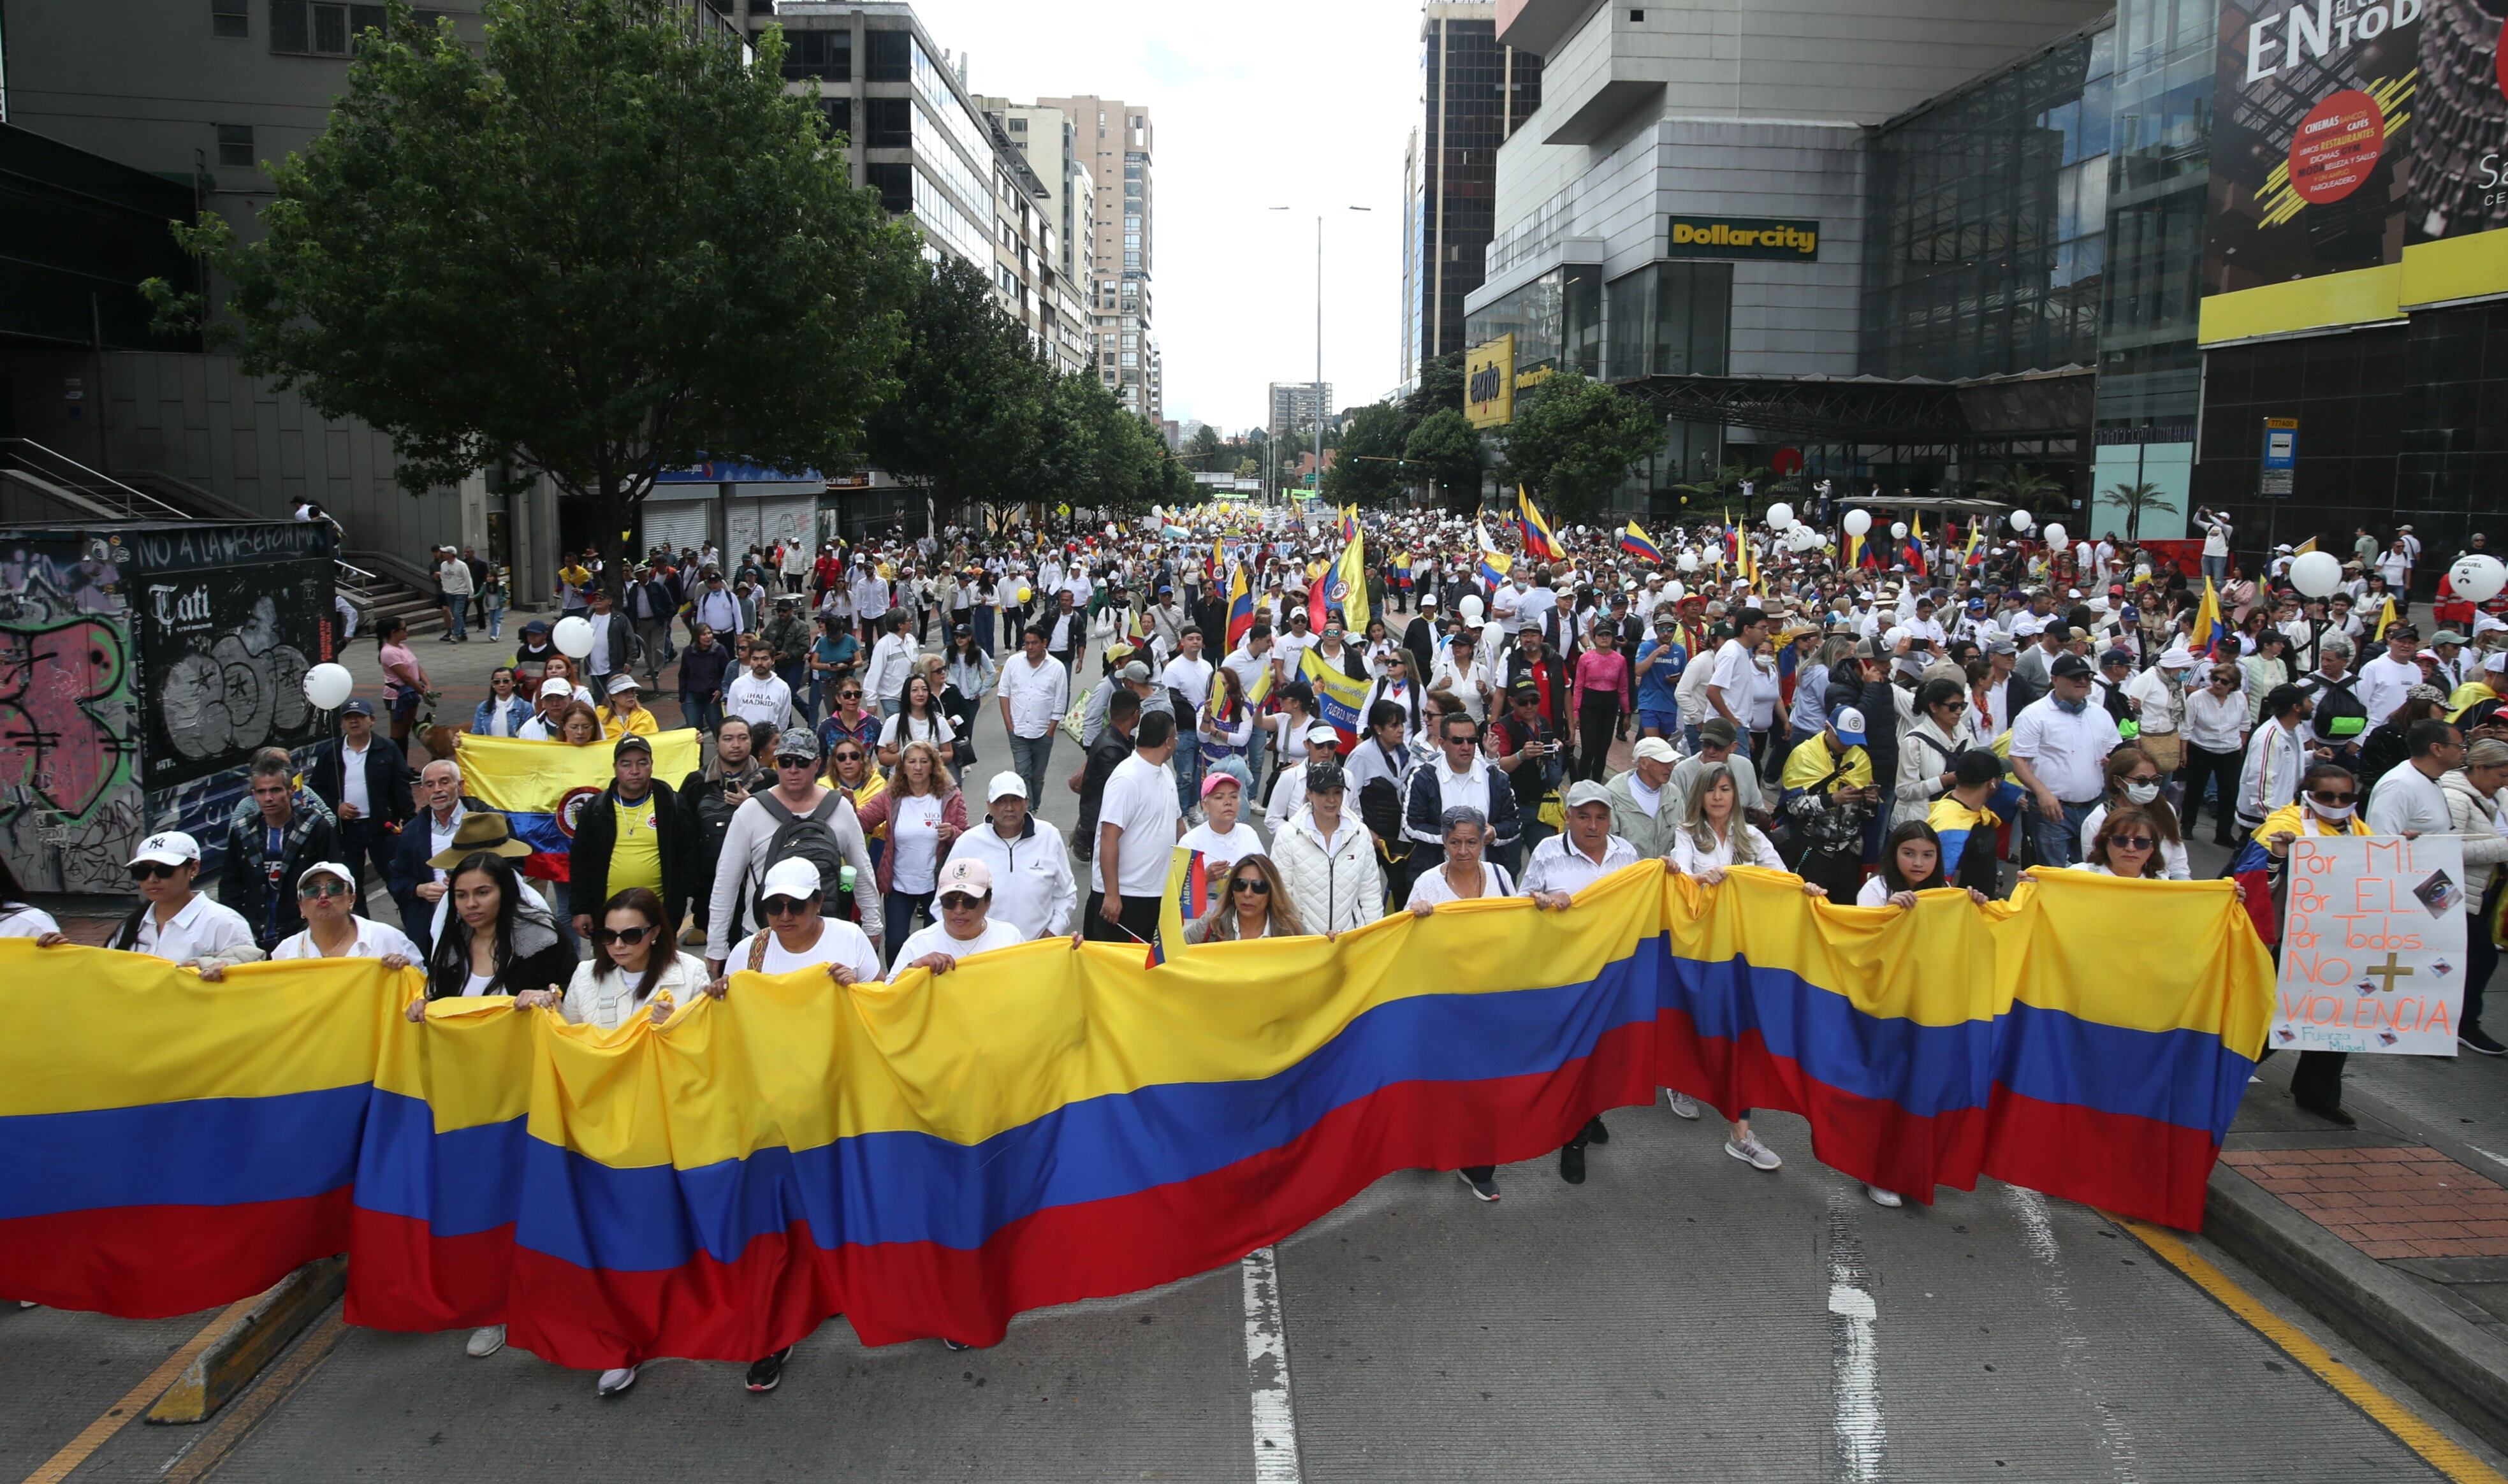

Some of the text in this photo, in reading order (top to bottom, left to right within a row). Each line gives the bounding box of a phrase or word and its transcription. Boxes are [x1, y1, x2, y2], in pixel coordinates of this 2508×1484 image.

[2335, 0, 2351, 17] EL
[2247, 0, 2332, 84] EN
[2305, 110, 2367, 134] CINEMAS BANCOS
[2347, 118, 2369, 131] CAFÉS
[2300, 127, 2375, 156] LIBROS RESTAURANTES
[2310, 144, 2361, 164] IDIOMAS GYM
[2298, 163, 2325, 178] MODA
[2324, 159, 2349, 171] BELLEZA
[2356, 152, 2377, 163] SALUD
[2310, 175, 2357, 193] PARQUEADERO
[1673, 224, 1816, 253] Dollarcity
[1470, 360, 1500, 404] éxito
[138, 537, 171, 568] NO
[180, 530, 196, 563] A
[200, 532, 222, 565] LA
[149, 583, 212, 628] Tati
[1324, 702, 1345, 720] FUERZA
[2294, 840, 2337, 875] Por
[2291, 878, 2331, 913] Por
[2287, 913, 2321, 949] Por
[2286, 950, 2352, 986] NO
[2301, 1026, 2351, 1041] Fuerza
